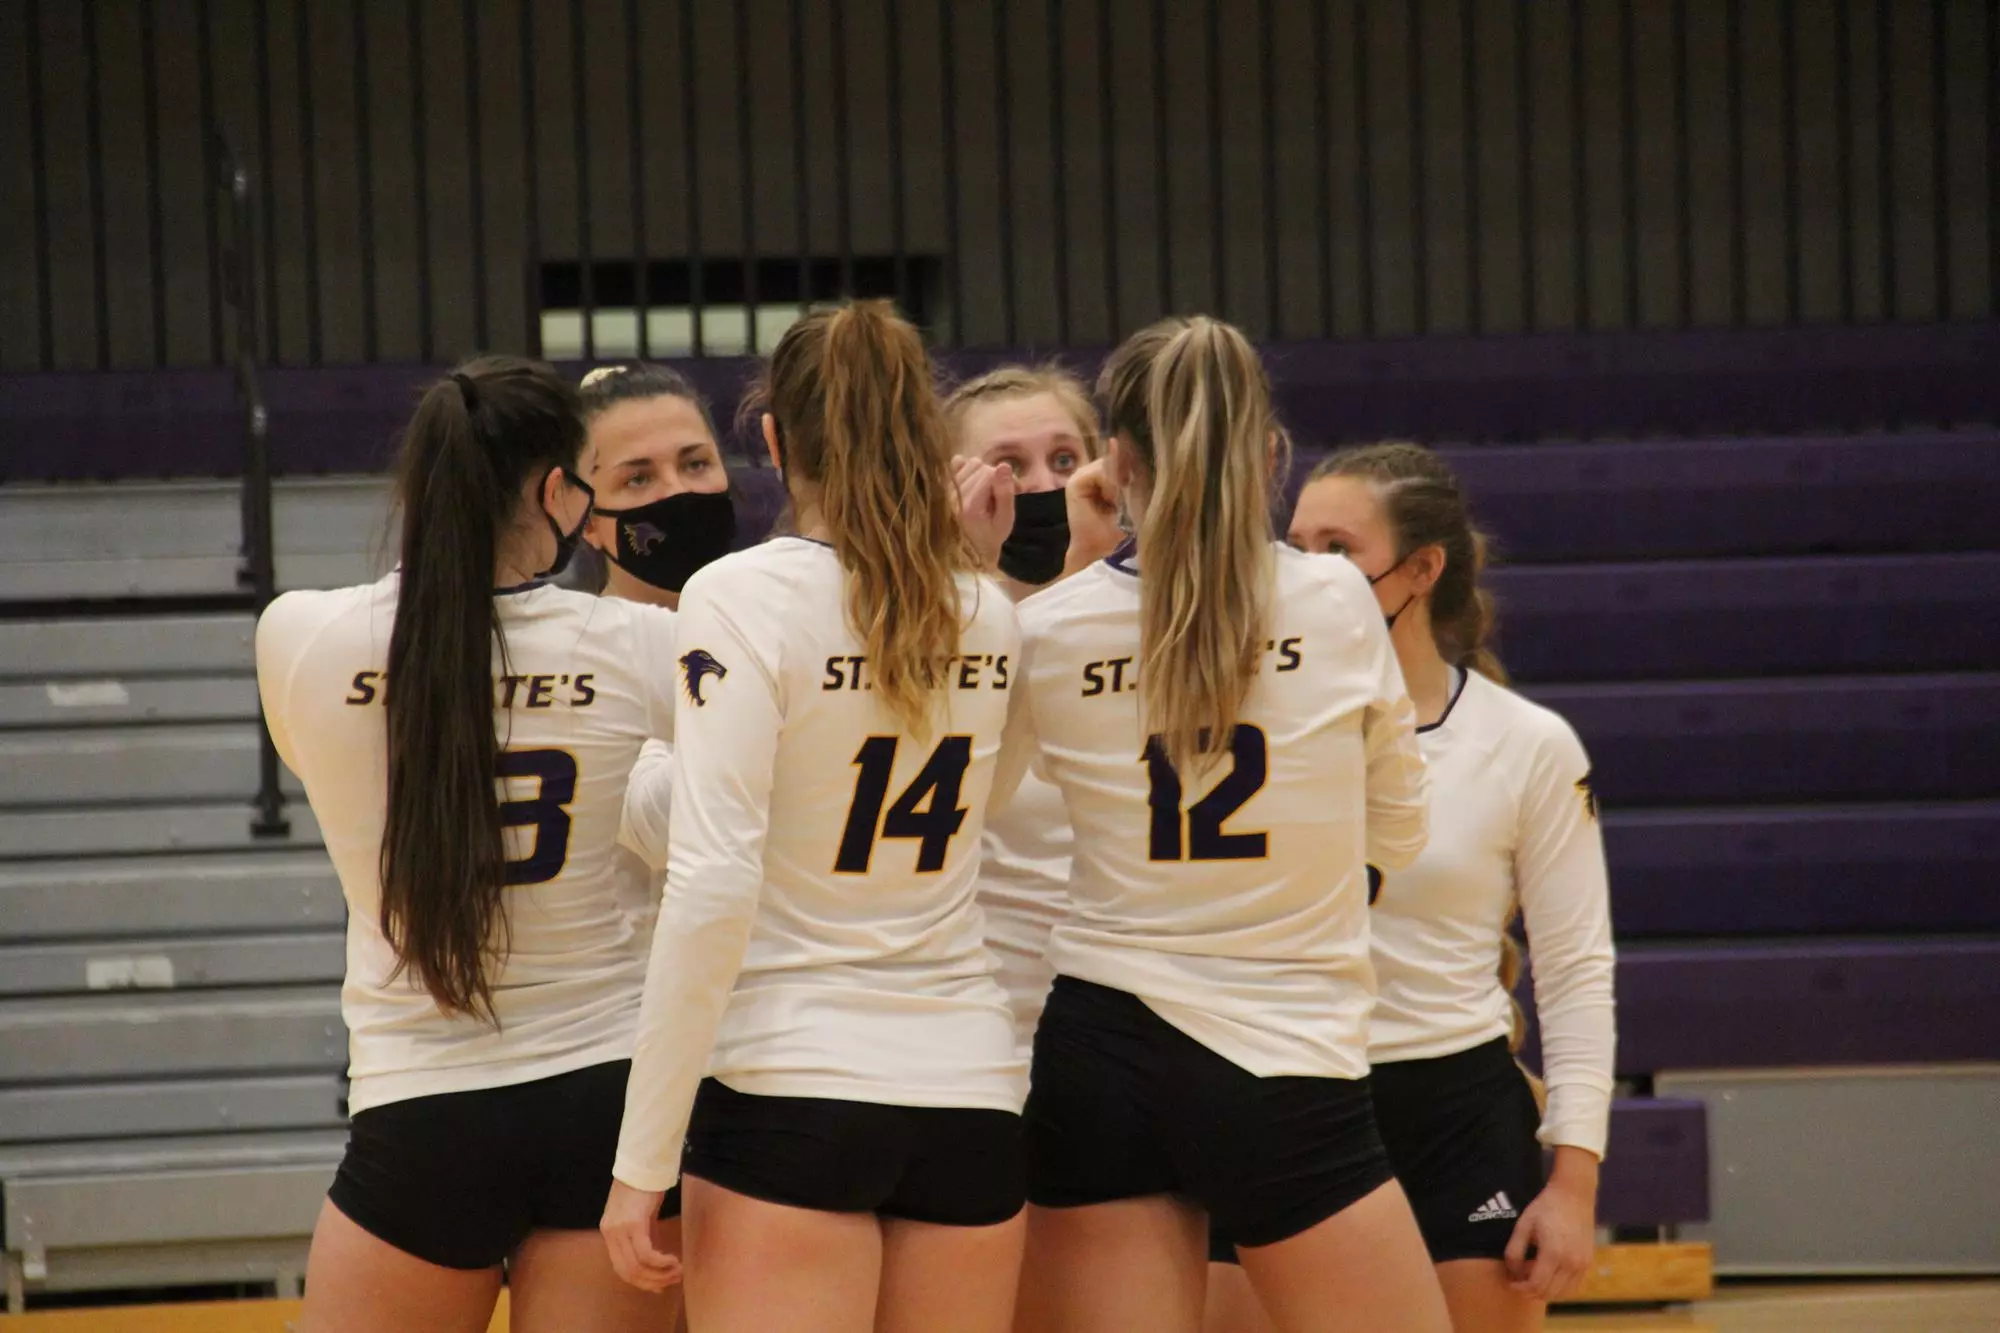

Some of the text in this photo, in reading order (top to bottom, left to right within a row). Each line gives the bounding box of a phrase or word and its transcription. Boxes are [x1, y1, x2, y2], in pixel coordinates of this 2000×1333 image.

[497, 674, 596, 708] TE'S
[1081, 656, 1137, 697] ST.
[832, 734, 974, 875] 14
[1138, 721, 1270, 863] 12
